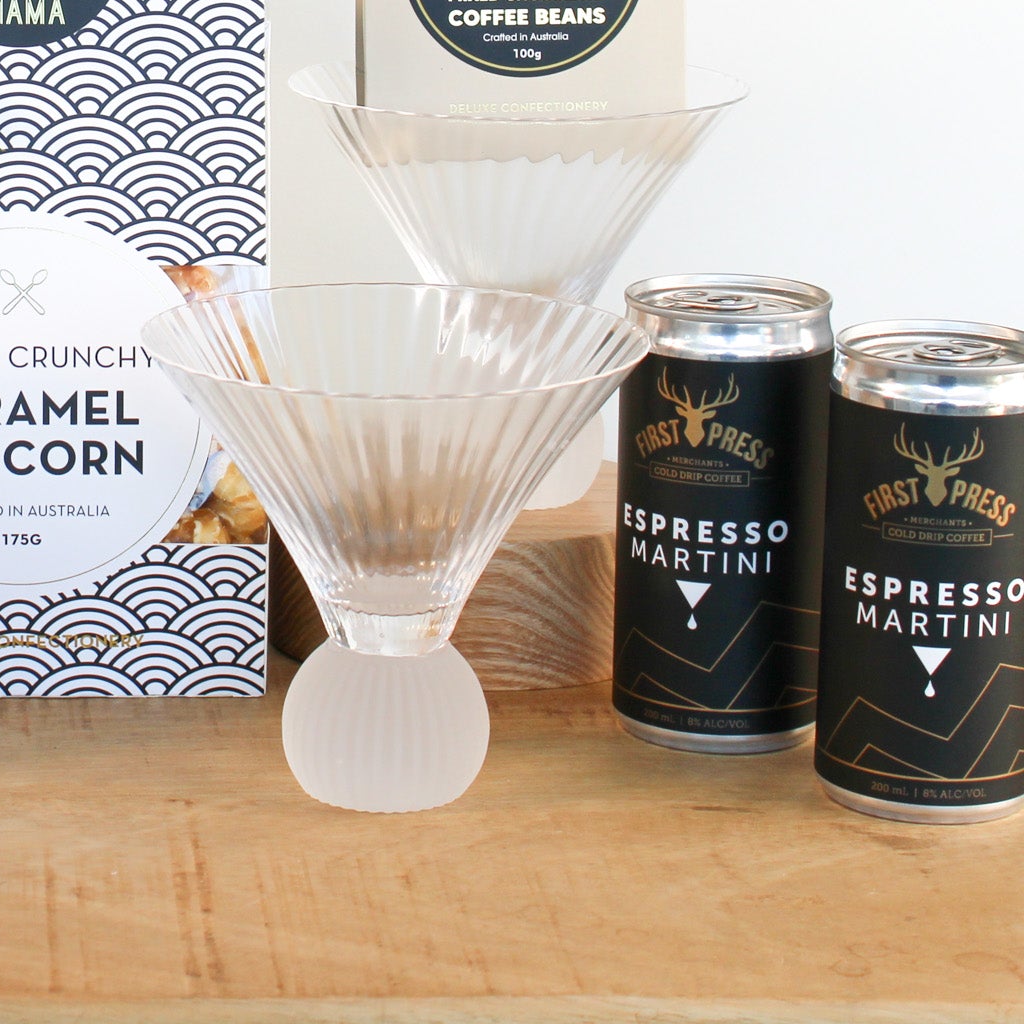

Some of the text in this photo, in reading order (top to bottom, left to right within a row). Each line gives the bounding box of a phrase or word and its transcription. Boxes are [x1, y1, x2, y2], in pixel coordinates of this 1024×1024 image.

[448, 7, 606, 26] COFFEE BEANS
[482, 32, 569, 42] Crafted in Australia
[513, 48, 542, 61] 100g
[449, 101, 608, 114] DELUXE CONFECTIONERY
[8, 346, 153, 368] CRUNCHY
[635, 419, 774, 470] FIRST PRESS
[671, 456, 724, 468] MERCHANTS
[654, 466, 742, 484] COLD DRIP COFFEE
[8, 505, 23, 517] IN
[28, 505, 110, 517] AUSTRALIA
[864, 477, 1016, 527] FIRST PRESS
[624, 502, 789, 545] ESPRESSO
[910, 516, 967, 527] MERCHANTS
[2, 533, 42, 546] 175G
[887, 527, 985, 543] COLD DRIP COFFEE
[631, 536, 771, 575] MARTINI
[845, 565, 1024, 607] ESPRESSO
[856, 601, 1010, 638] MARTINI
[871, 781, 890, 793] 200
[939, 788, 987, 799] ALC/VOL
